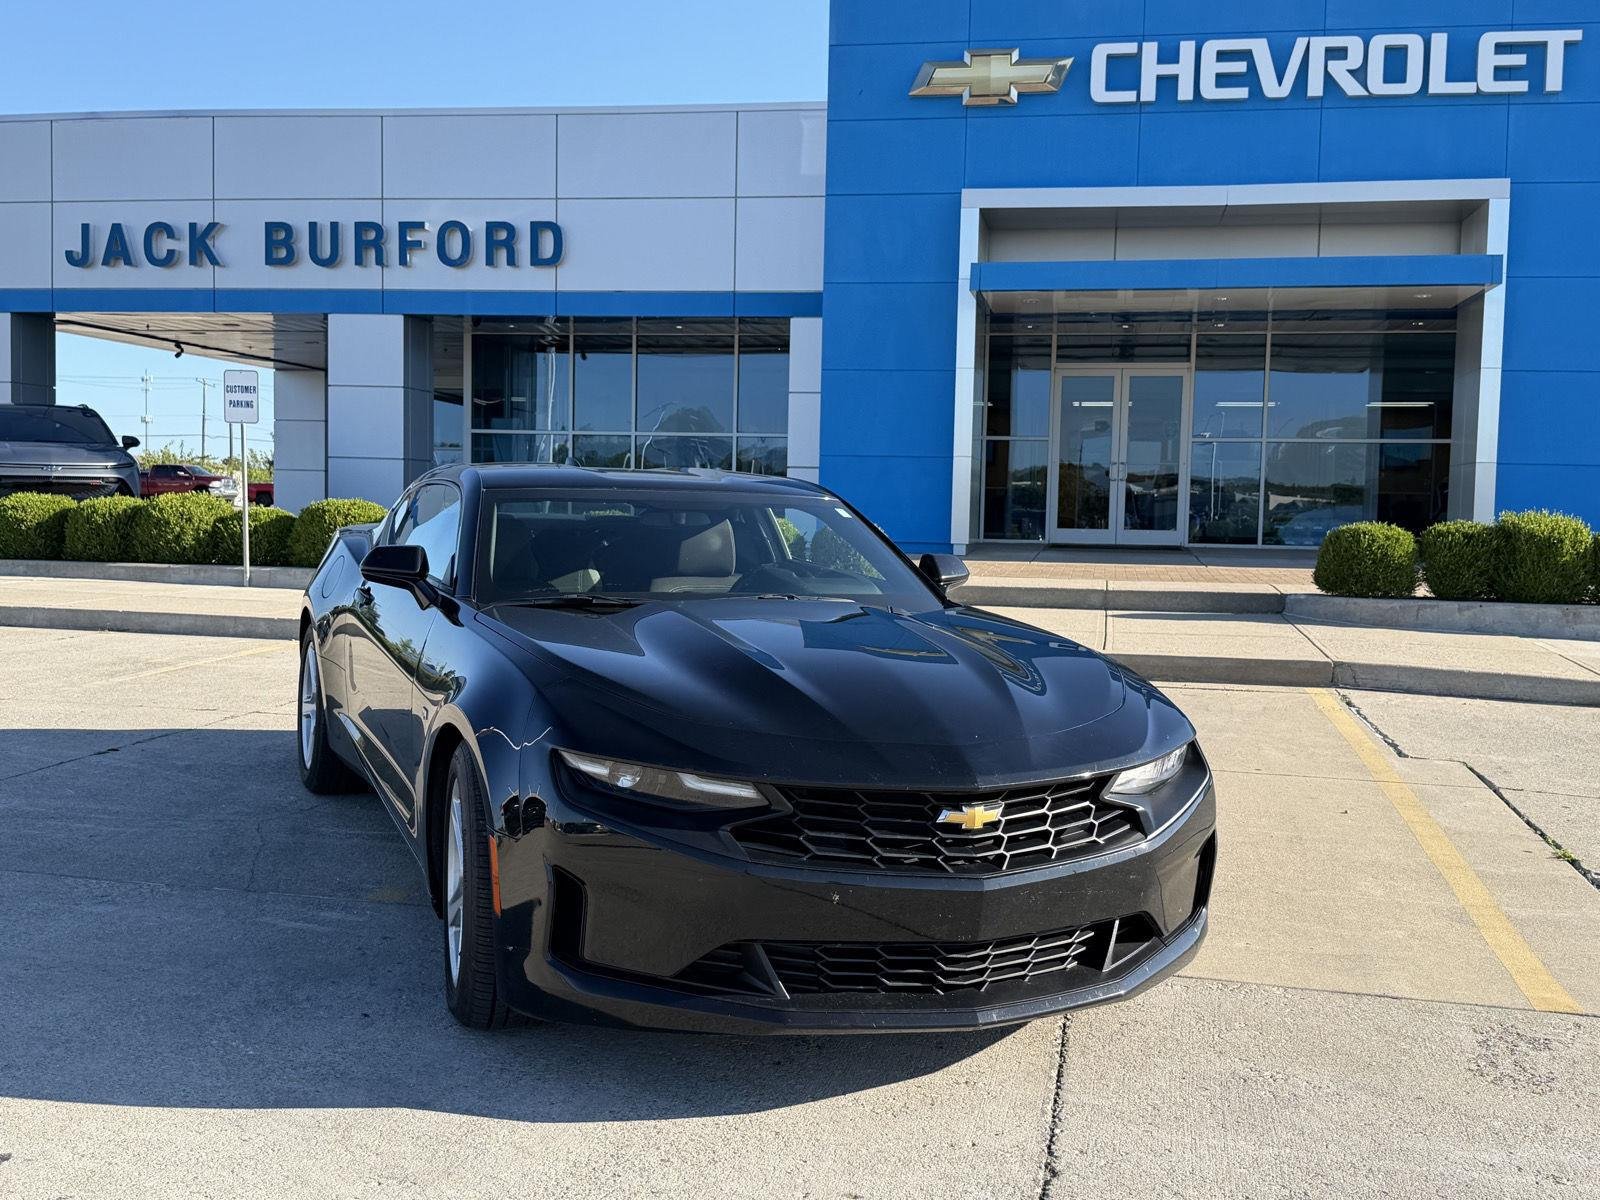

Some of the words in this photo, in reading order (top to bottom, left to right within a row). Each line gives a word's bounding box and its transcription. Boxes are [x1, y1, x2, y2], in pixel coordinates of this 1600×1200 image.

[1090, 29, 1583, 104] CHEVROLET
[65, 221, 221, 268] JACK
[264, 220, 564, 268] BURFORD
[225, 385, 257, 394] CUSTOMER
[229, 399, 254, 409] PARKING
